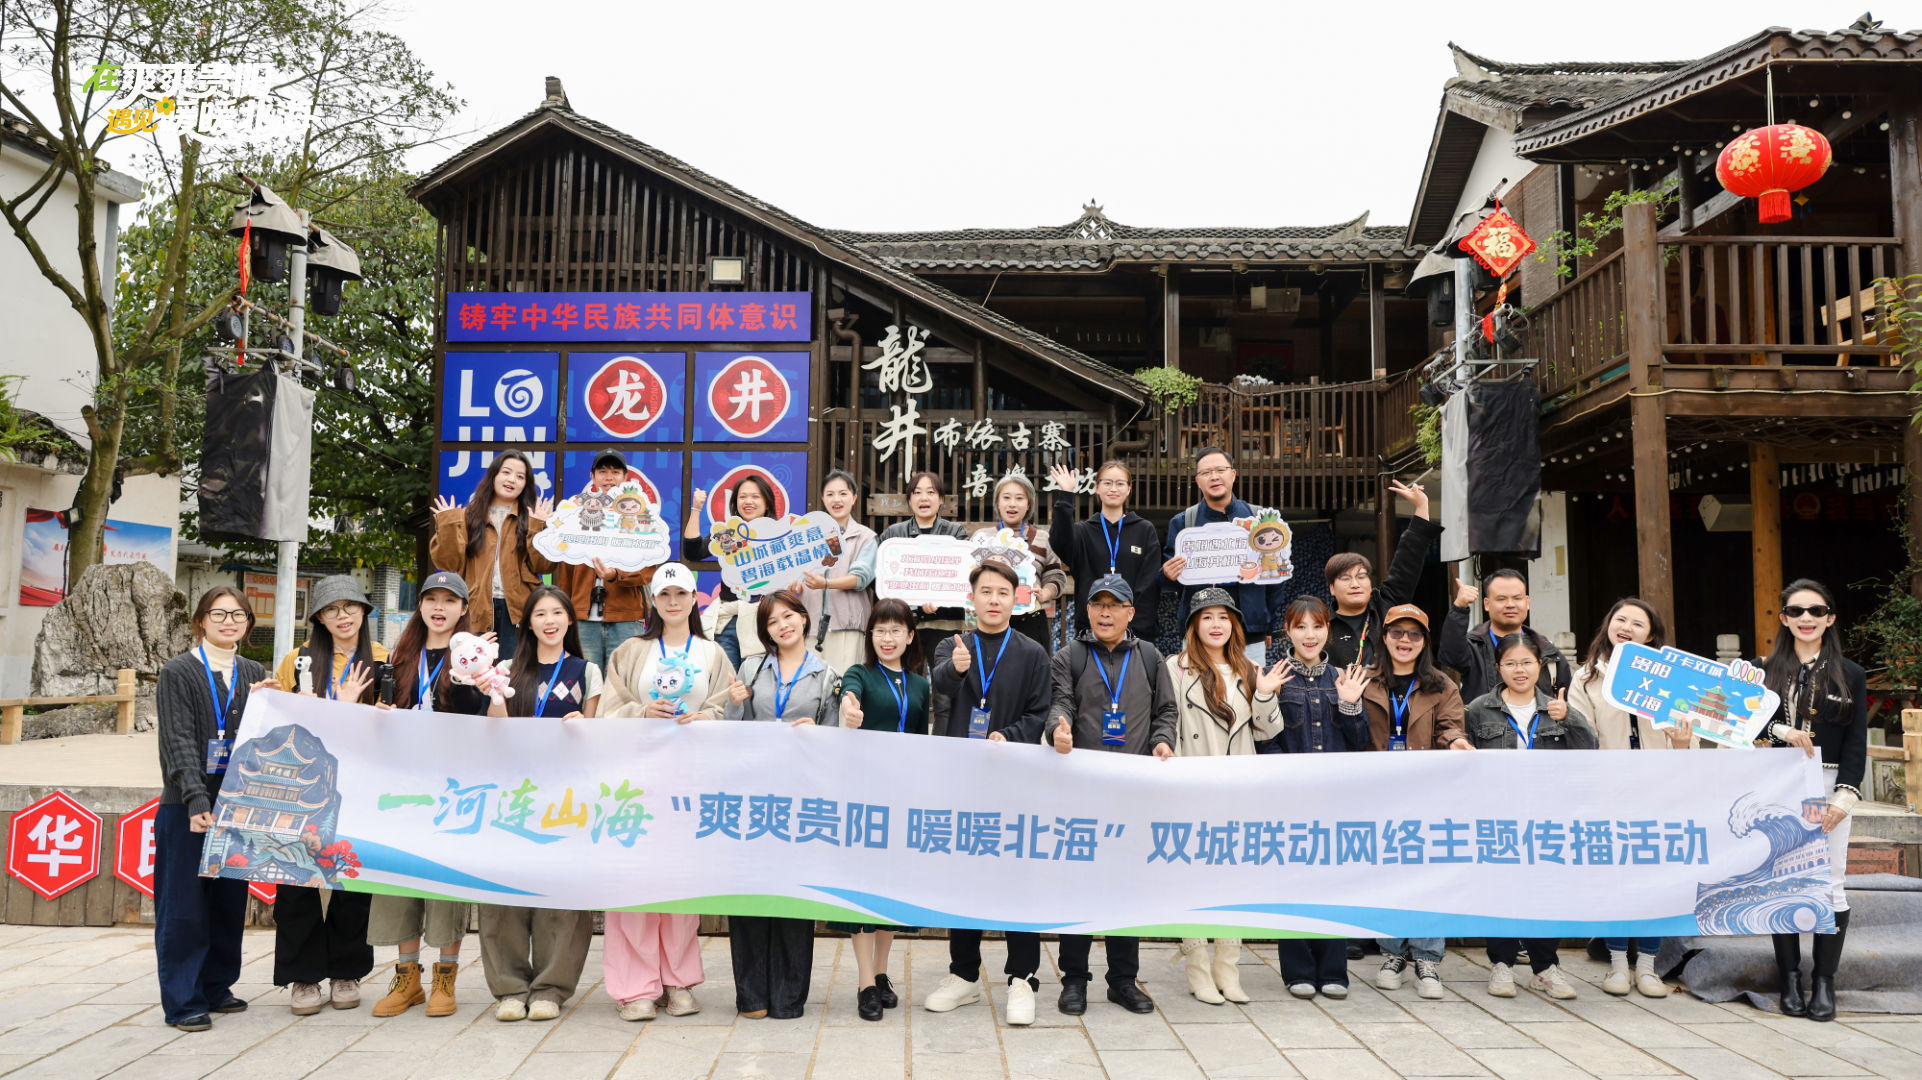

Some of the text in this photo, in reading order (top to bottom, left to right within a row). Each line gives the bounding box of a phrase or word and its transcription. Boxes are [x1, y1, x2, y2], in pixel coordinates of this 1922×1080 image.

[1483, 227, 1517, 259] 福
[458, 302, 799, 331] 铸牢中华民族共同体意识
[601, 369, 650, 421] 龙
[727, 368, 775, 423] 井
[933, 417, 1072, 457] 布依古寨
[733, 525, 825, 568] 山城藏爽意
[740, 543, 830, 584] 碧海载温情
[1629, 654, 1673, 680] 贵阳
[1663, 651, 1724, 680] 打卡双城
[1621, 688, 1664, 713] 北海
[377, 777, 1710, 866] 一河连山海 “爽爽贵阳 暖暖北海” 双城联动网络主题传播活动
[27, 813, 84, 878] 华
